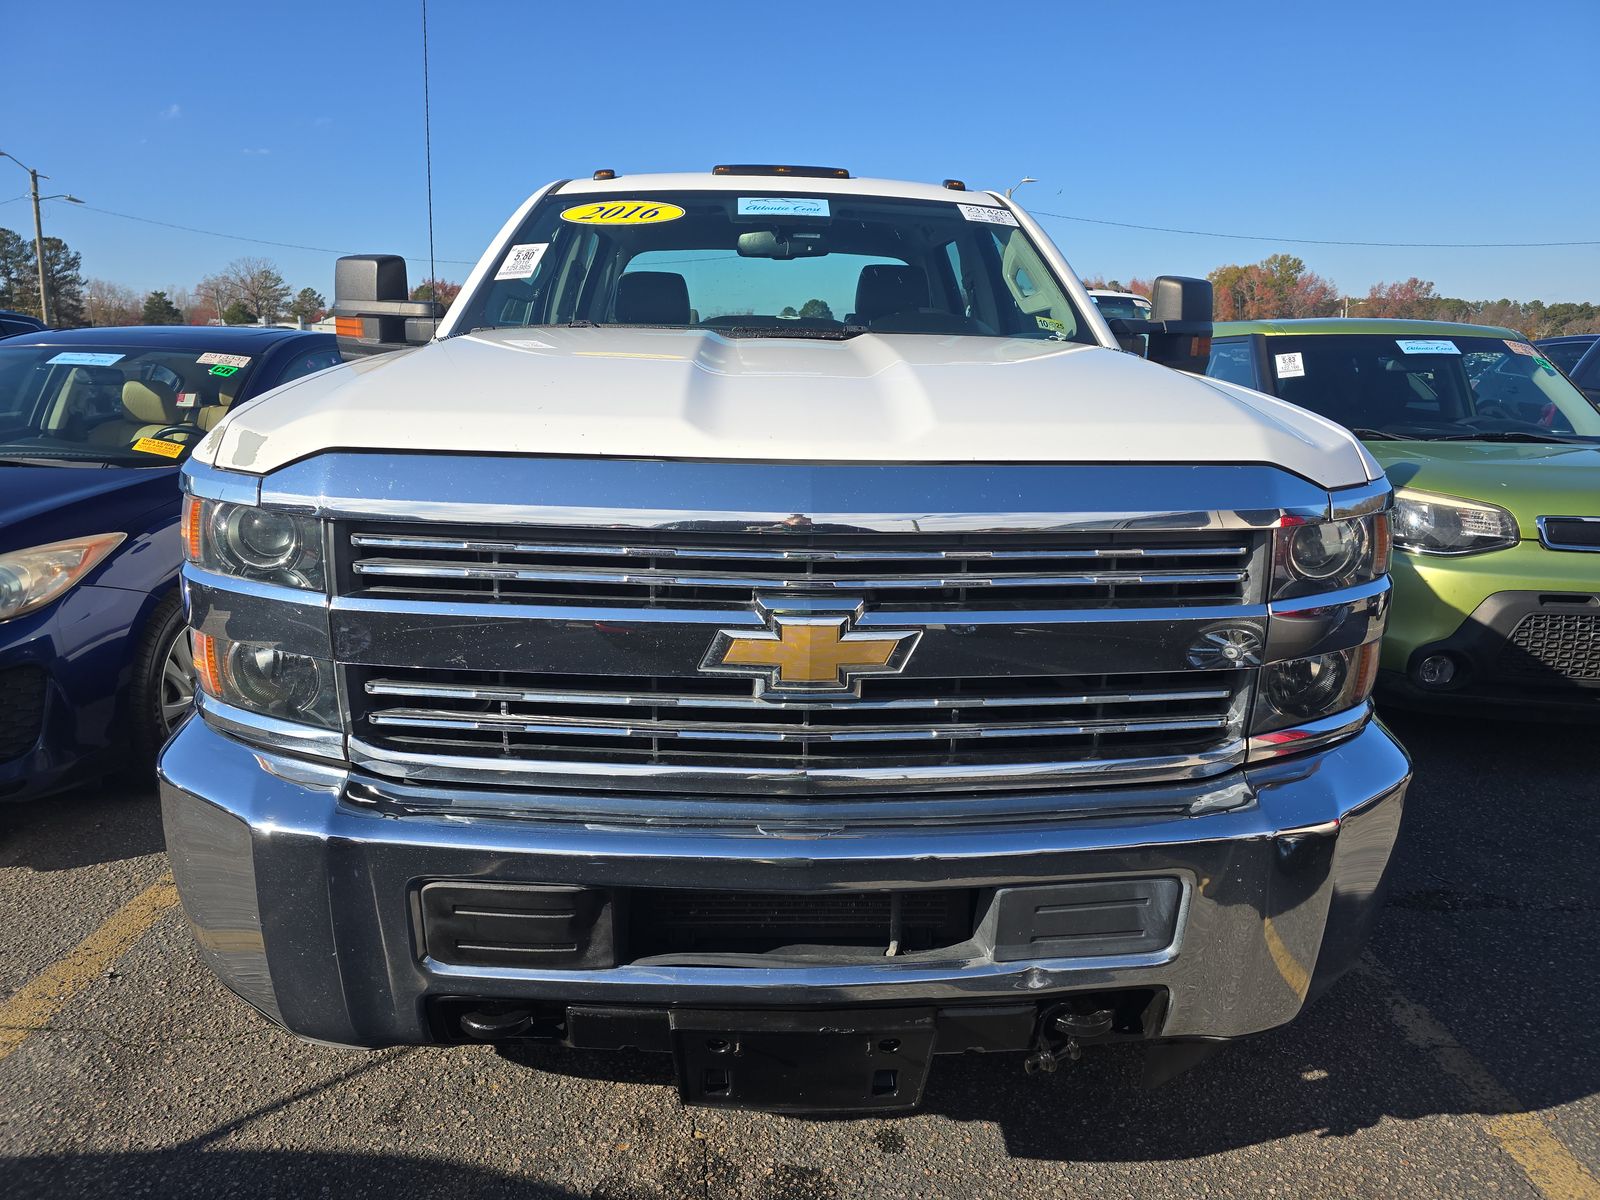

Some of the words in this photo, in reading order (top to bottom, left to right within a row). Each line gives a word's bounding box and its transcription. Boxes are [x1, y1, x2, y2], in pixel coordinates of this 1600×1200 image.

[577, 205, 668, 220] 2016
[1039, 319, 1048, 328] 10
[157, 441, 181, 449] VEHICLE
